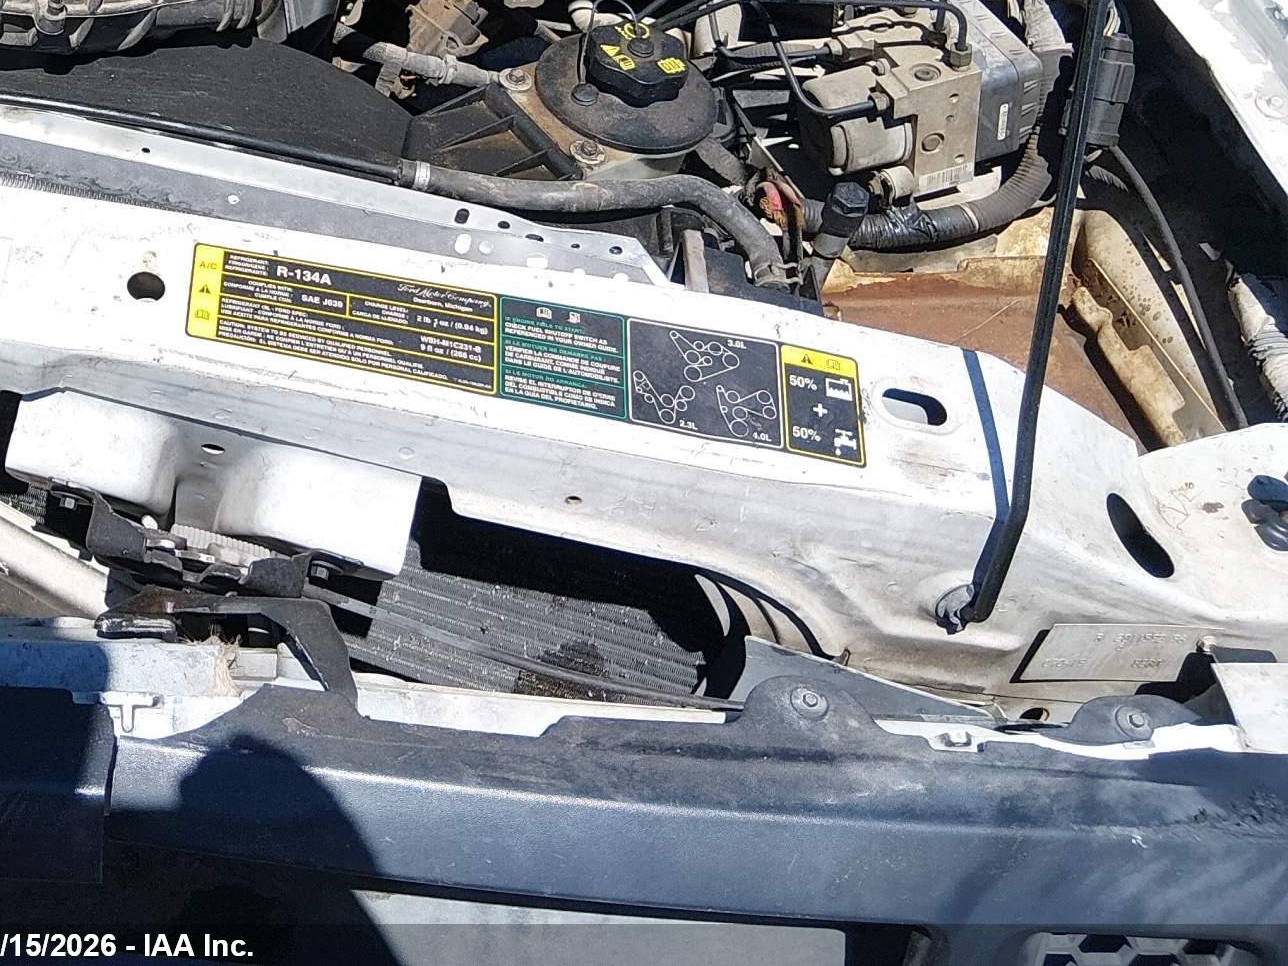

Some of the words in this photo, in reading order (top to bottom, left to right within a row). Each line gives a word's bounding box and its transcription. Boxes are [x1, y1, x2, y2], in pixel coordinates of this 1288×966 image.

[199, 261, 217, 270] A/C
[276, 265, 332, 285] R-134A
[397, 282, 419, 296] Ford
[417, 286, 444, 300] Motor
[301, 294, 320, 304] SAE
[351, 309, 371, 317] CARGA
[444, 302, 472, 312] Michigan
[423, 316, 430, 324] lb
[439, 319, 449, 327] oz
[454, 321, 473, 331] (0.94
[475, 325, 488, 334] kg)
[505, 322, 526, 330] CHECK
[504, 327, 546, 339] REFERENCED
[554, 336, 572, 344] YOUR
[573, 340, 596, 349] OWNER
[434, 346, 443, 354] oz
[468, 352, 481, 361] cc)
[543, 352, 579, 363] COMMANDE
[590, 361, 620, 371] COUPURE
[555, 360, 578, 369] COMME
[505, 374, 526, 383] REVISE
[789, 374, 818, 391] 50%
[518, 383, 562, 396] COMBUSTIBLE
[679, 419, 699, 431] 2.3L
[792, 426, 821, 442] 50%
